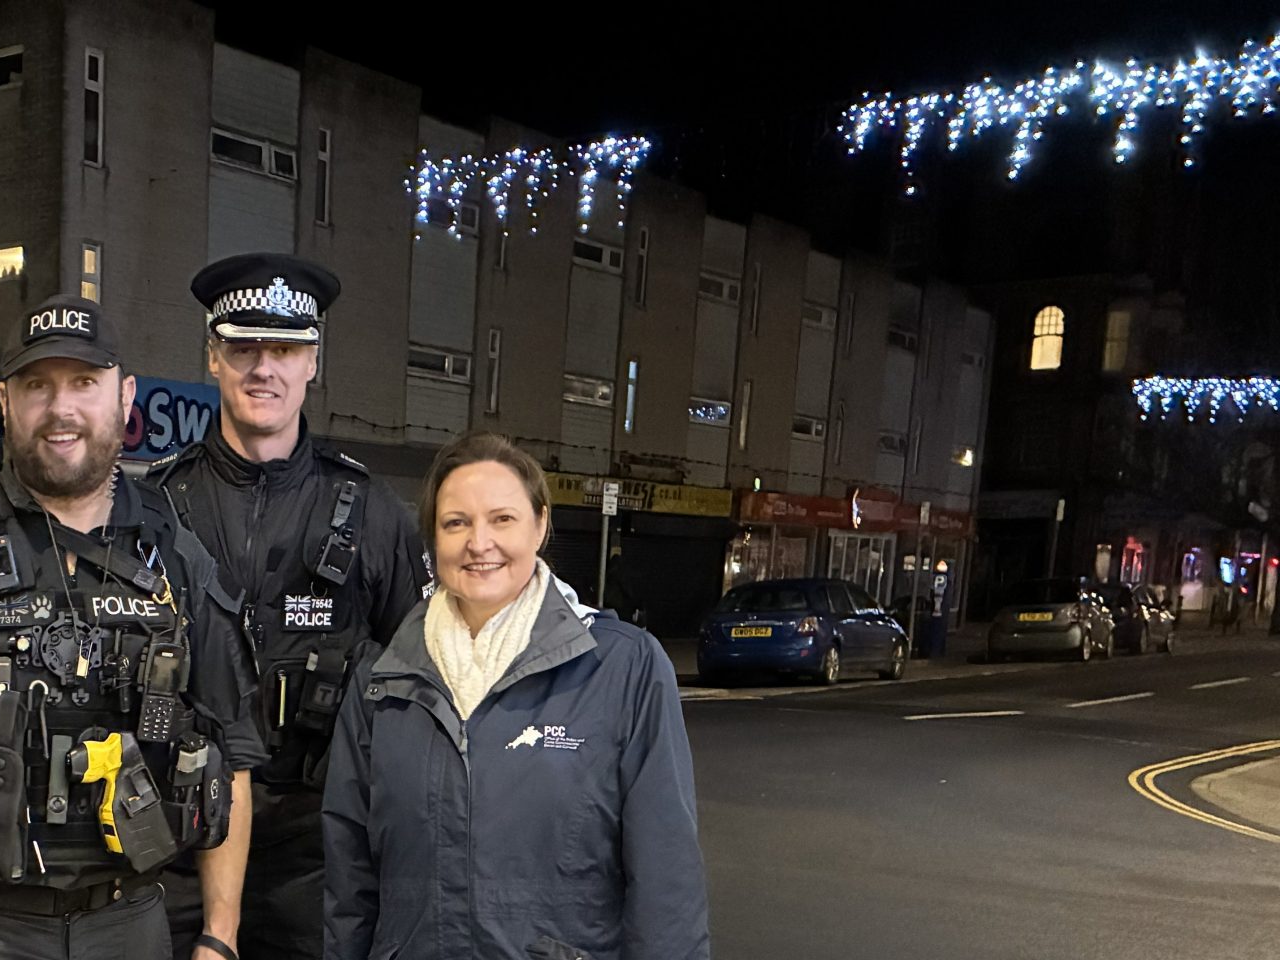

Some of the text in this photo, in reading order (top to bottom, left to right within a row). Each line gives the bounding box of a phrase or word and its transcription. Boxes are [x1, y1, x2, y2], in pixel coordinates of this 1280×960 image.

[30, 309, 90, 335] POLICE
[92, 596, 160, 617] POLICE
[285, 612, 332, 626] POLICE
[544, 725, 566, 737] PCC
